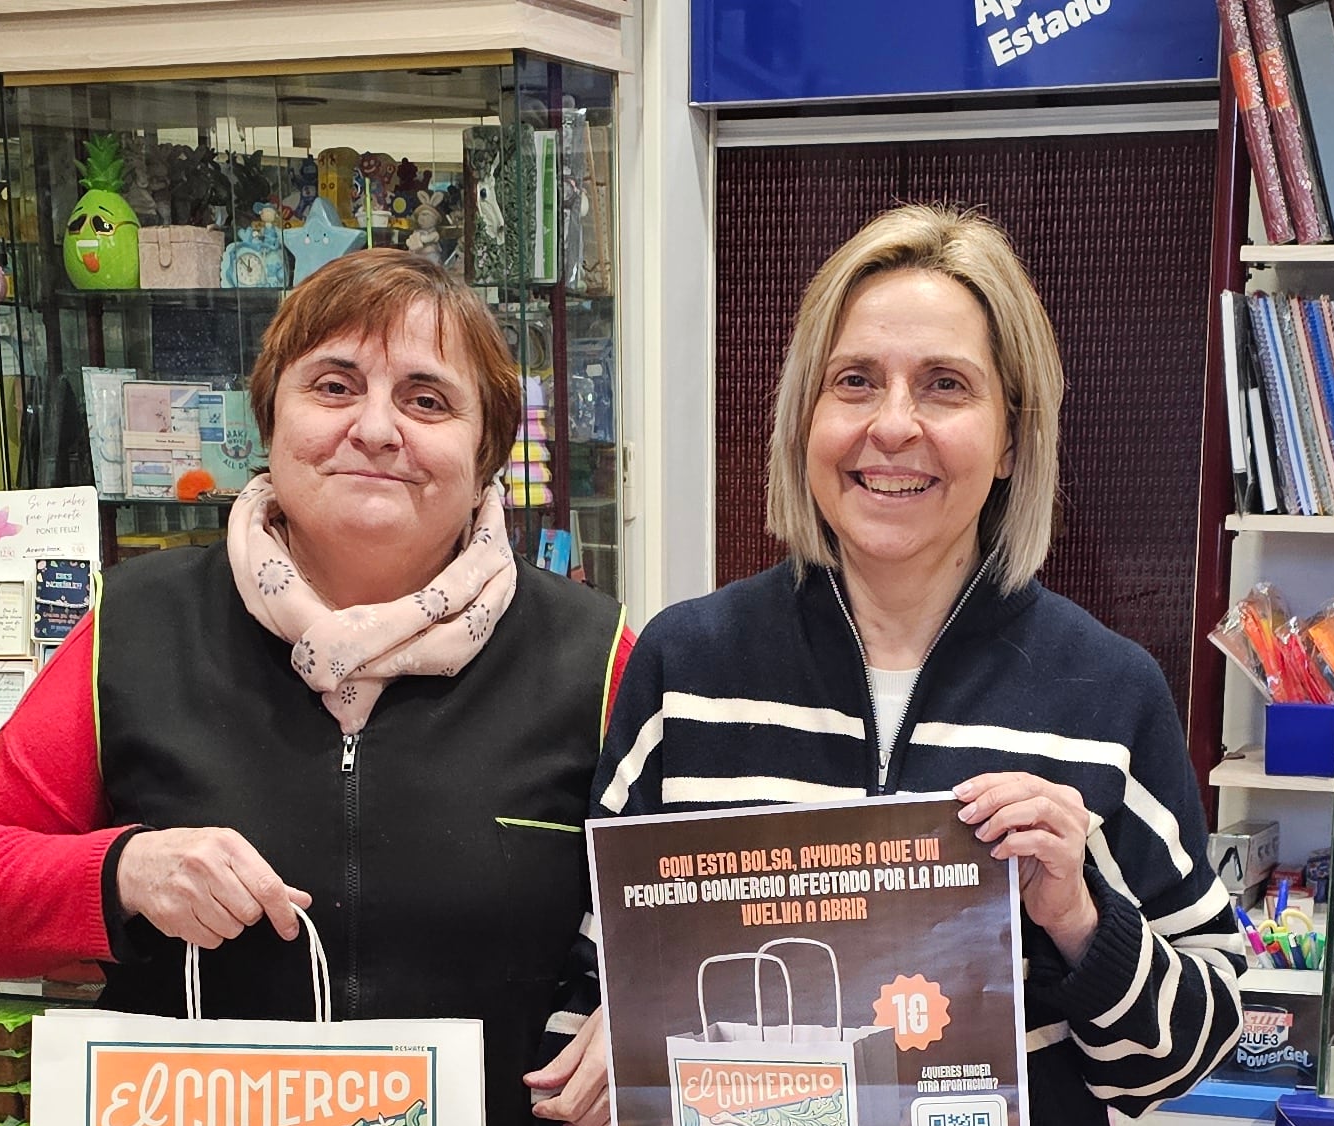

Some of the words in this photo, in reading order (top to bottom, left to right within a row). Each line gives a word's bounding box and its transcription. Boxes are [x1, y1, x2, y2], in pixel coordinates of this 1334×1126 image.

[987, 0, 1111, 67] Estado
[35, 527, 58, 535] PONTE
[658, 853, 695, 880] CON
[696, 850, 739, 878] ESTA
[740, 847, 798, 873] BOLSA,
[799, 843, 863, 869] AYUDAS
[865, 841, 878, 865] A
[880, 840, 913, 865] QUE
[914, 837, 941, 862] UN
[623, 876, 698, 908] PEQUEÑO
[701, 874, 786, 903] COMERCIO
[789, 870, 871, 898] AFECTADO
[873, 868, 906, 892] POR
[908, 867, 931, 888] LA
[933, 862, 980, 888] DANA
[741, 900, 803, 927] VUELVA
[805, 899, 817, 923] A
[820, 897, 868, 923] ABRIR
[892, 994, 929, 1036] 1€
[921, 1065, 963, 1079] ¿QUIERES
[962, 1063, 992, 1078] HACER
[1236, 1045, 1314, 1069] PowerGel
[684, 1073, 715, 1106] El
[716, 1070, 836, 1109] COMERCIO
[917, 1080, 940, 1093] OTRA
[940, 1077, 1000, 1092] APORTACIÓN?
